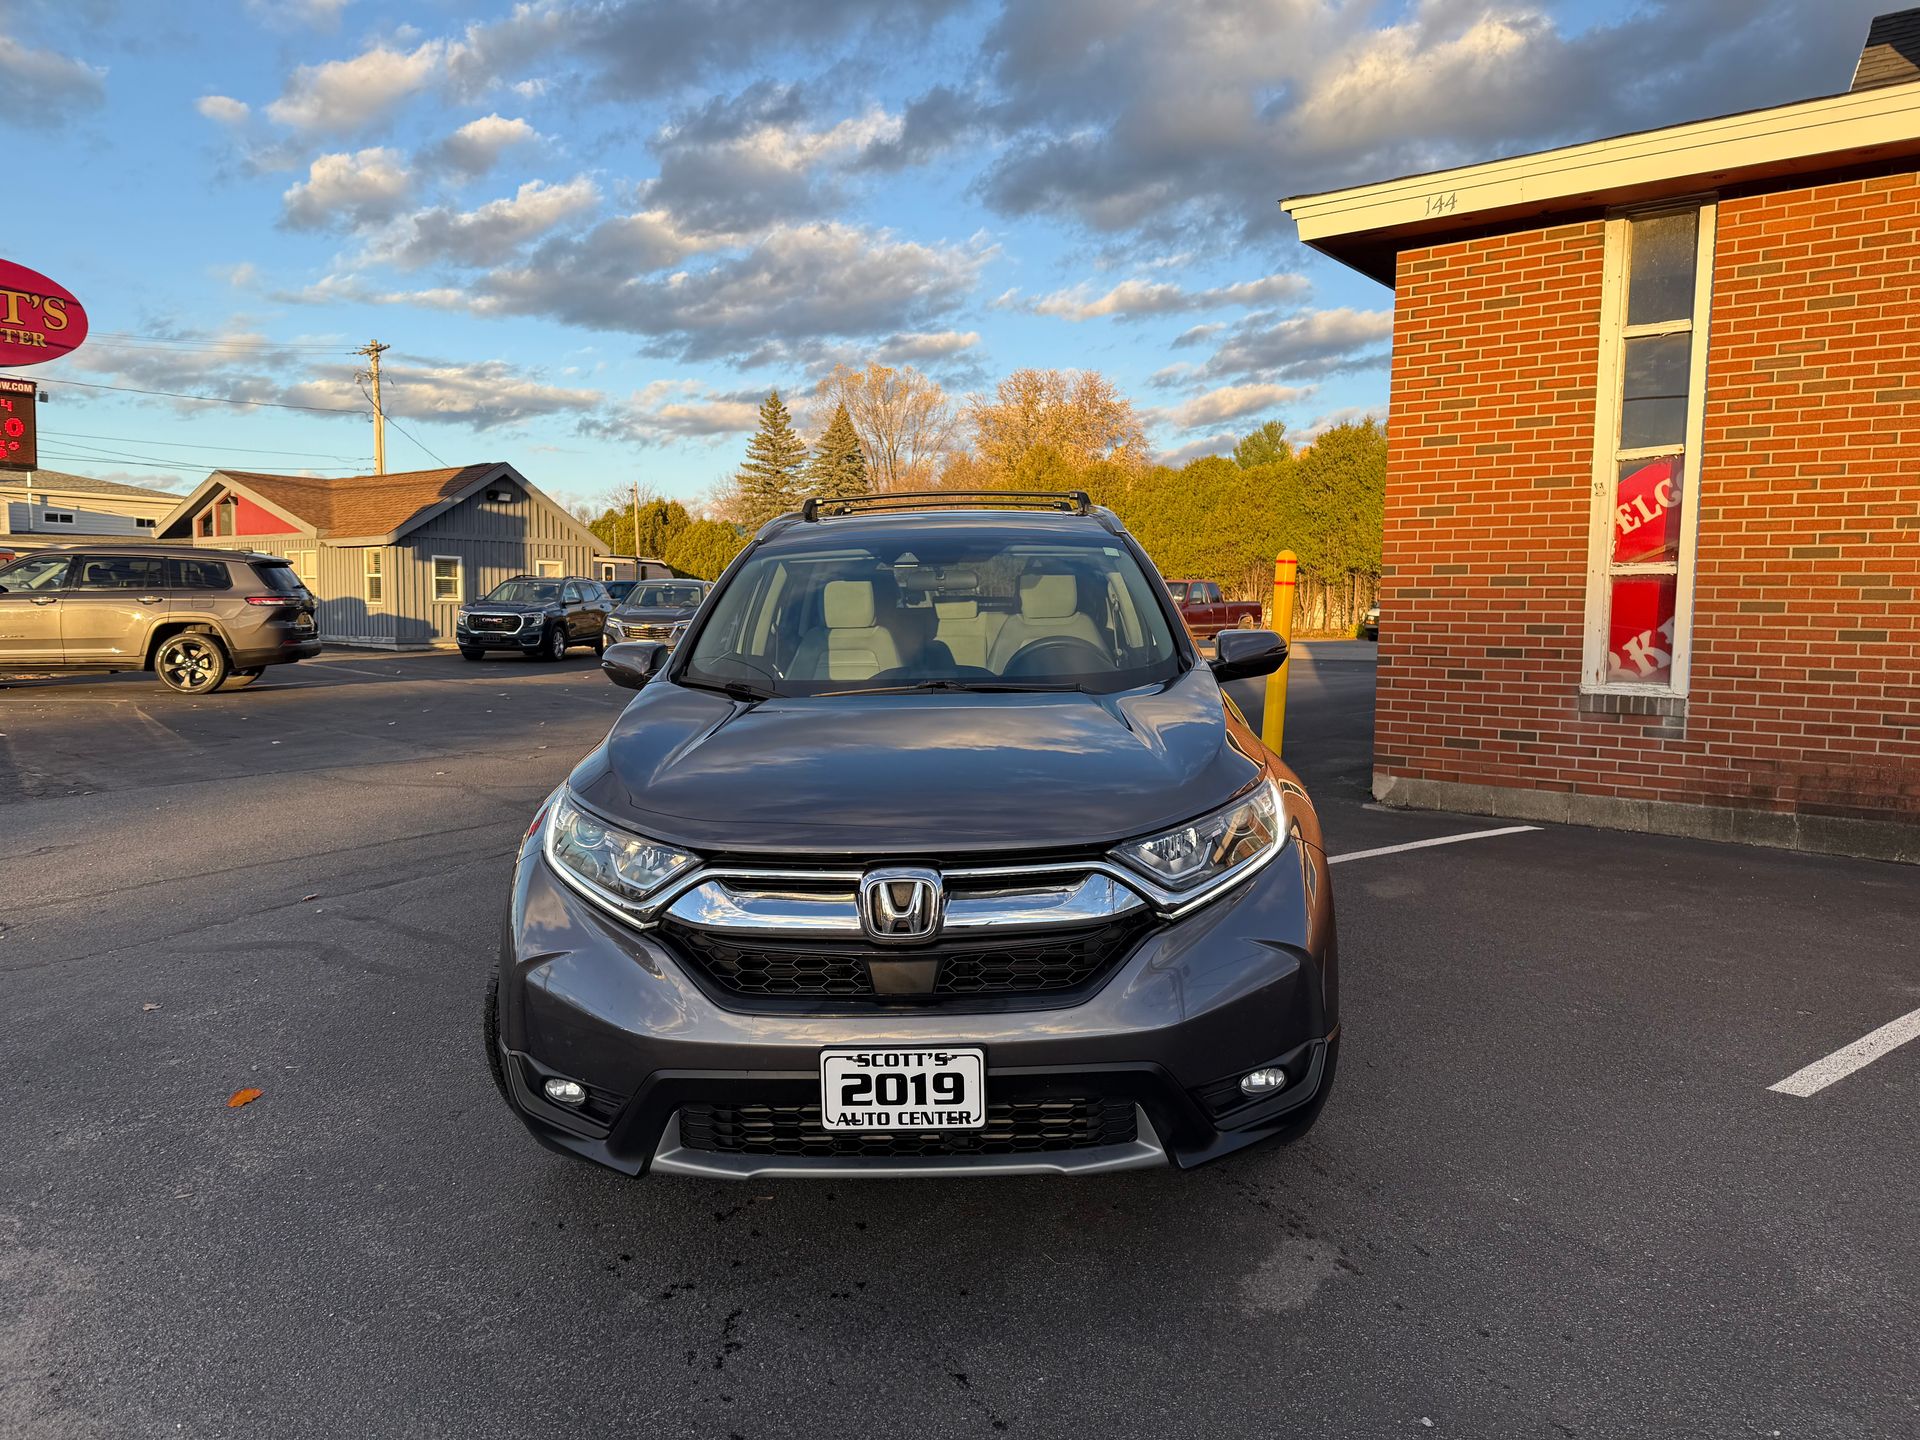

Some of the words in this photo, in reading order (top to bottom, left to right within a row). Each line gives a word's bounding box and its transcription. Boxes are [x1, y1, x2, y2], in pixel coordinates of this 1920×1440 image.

[1425, 192, 1458, 216] 144
[0, 290, 69, 331] T'S
[0, 328, 48, 348] TER
[0, 381, 33, 393] W.COM
[0, 417, 25, 437] 0
[857, 1053, 948, 1067] SCOTT'S
[841, 1072, 965, 1106] 2019
[836, 1112, 890, 1126] AUTO
[898, 1111, 972, 1125] CENTER
